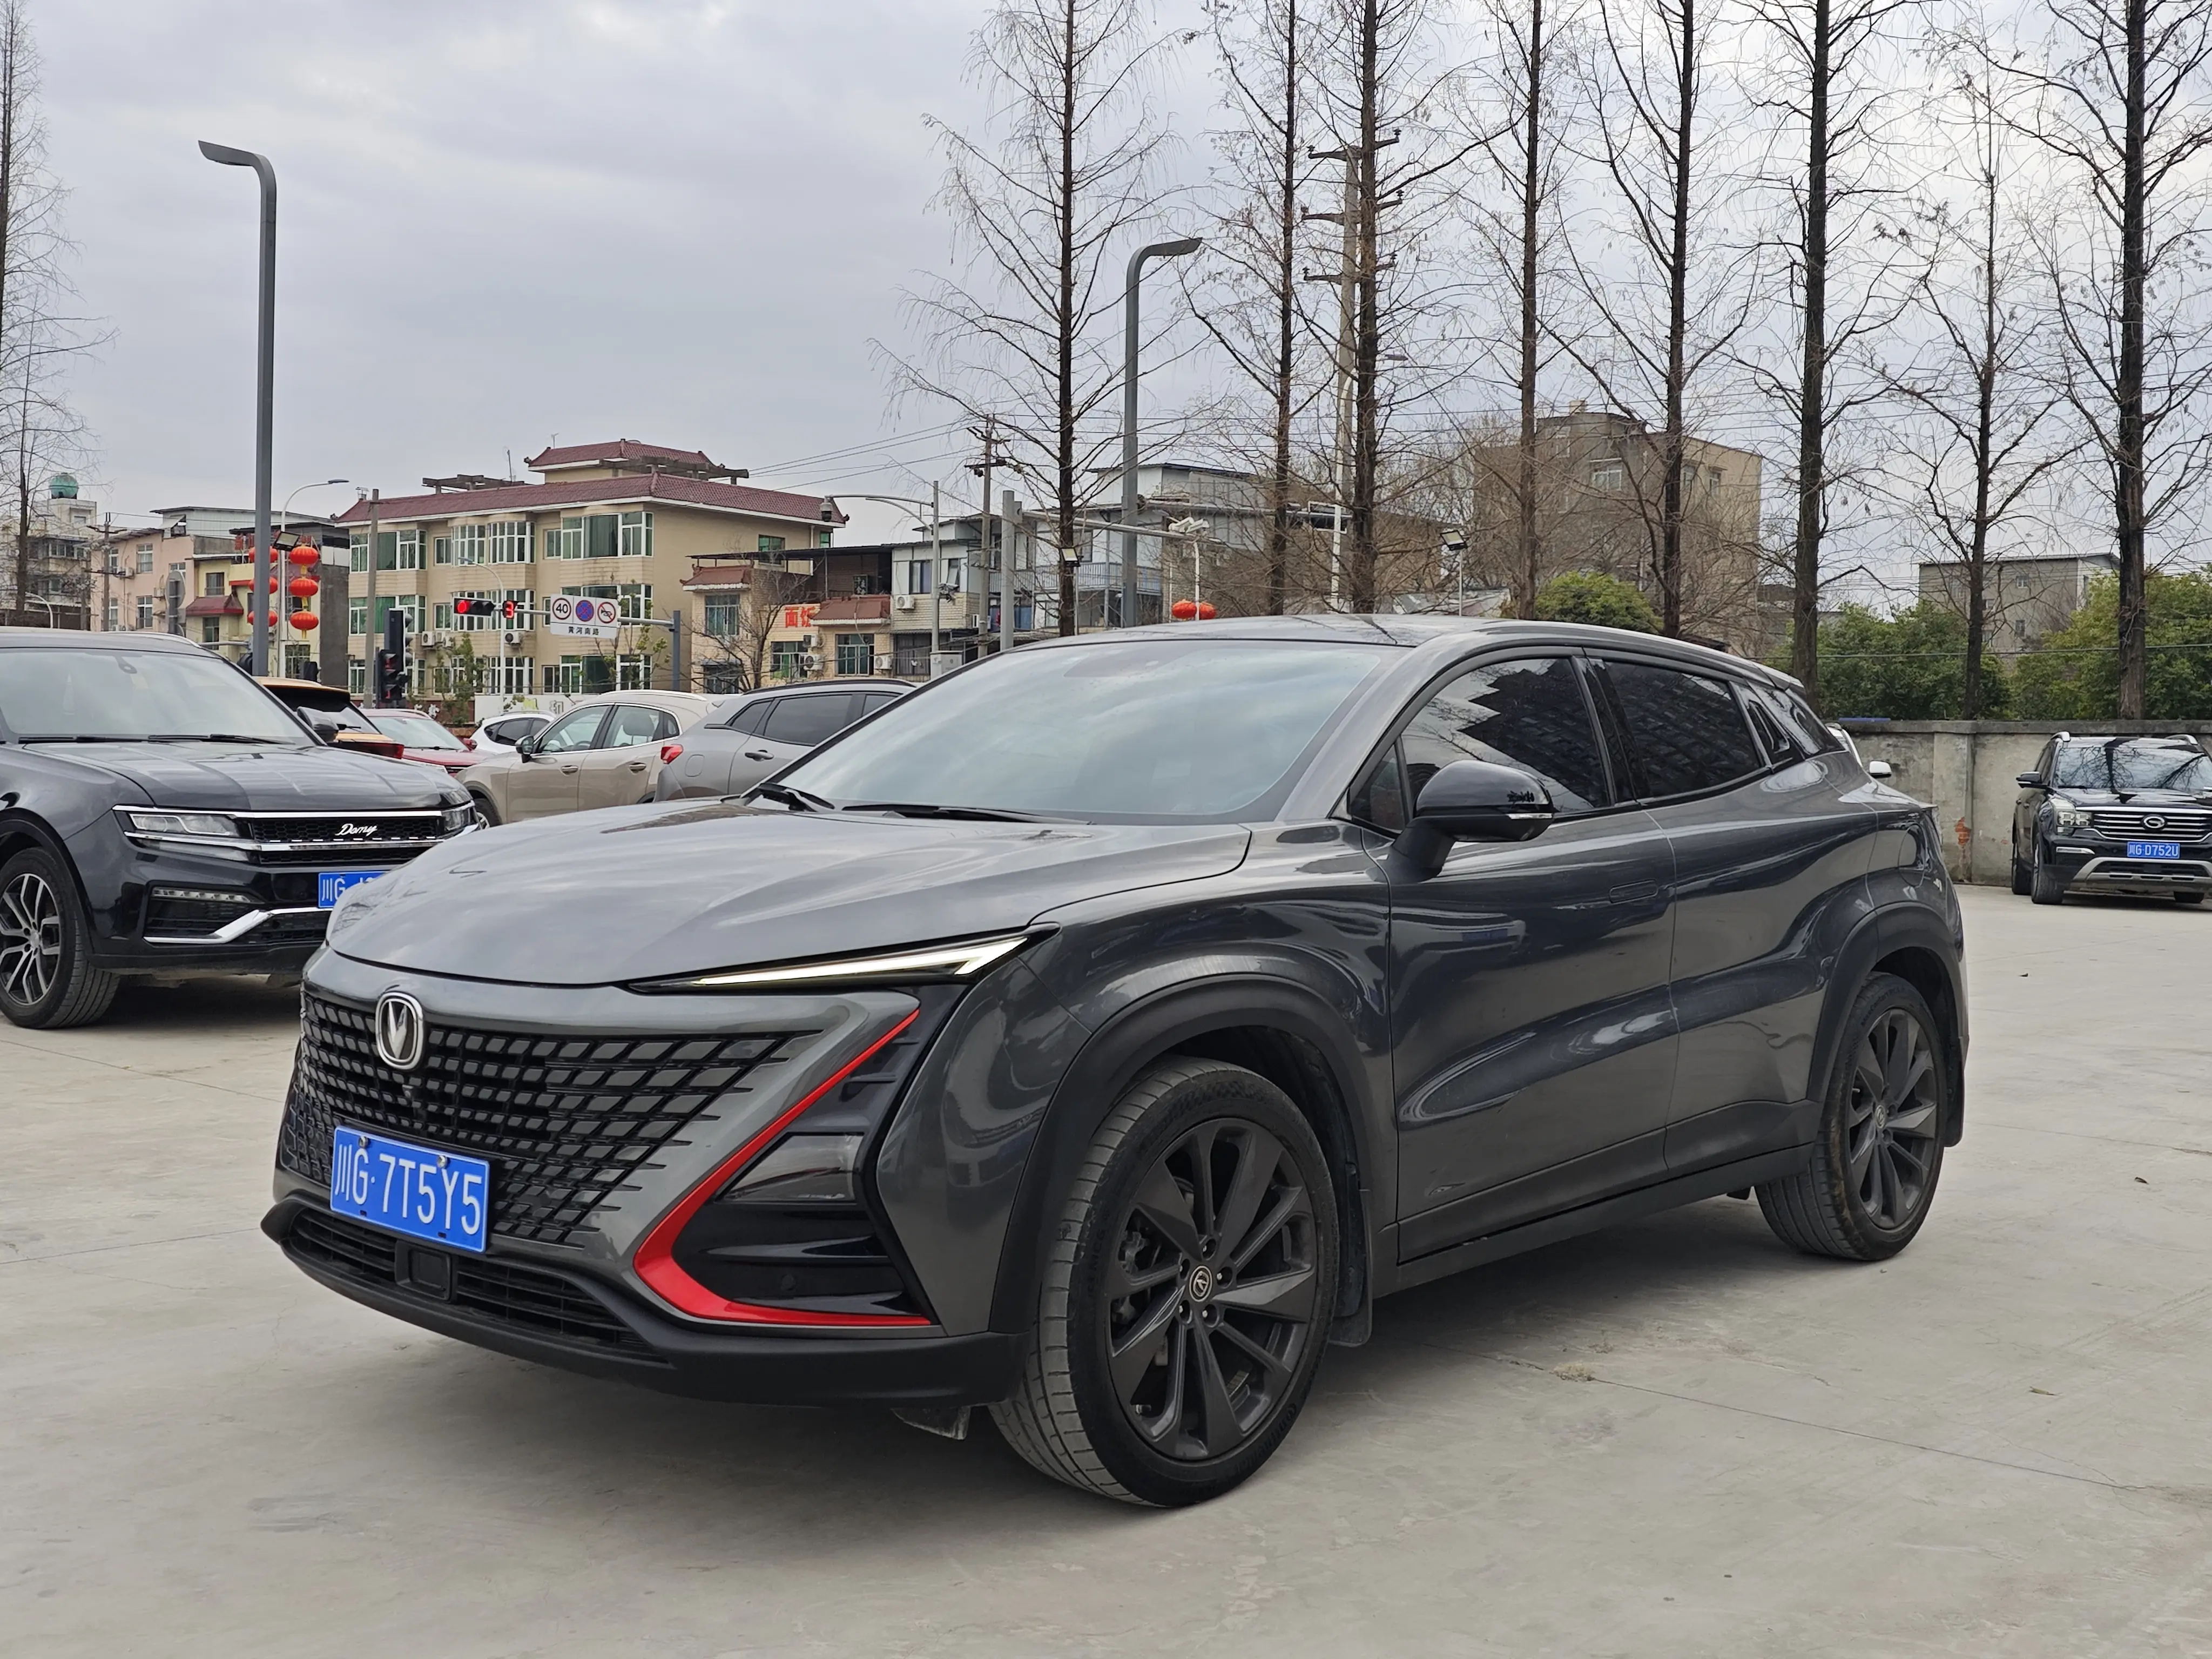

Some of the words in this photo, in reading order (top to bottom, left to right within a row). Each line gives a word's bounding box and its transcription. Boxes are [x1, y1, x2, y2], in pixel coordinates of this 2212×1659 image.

[556, 603, 568, 613] 40
[569, 626, 599, 635] 黄河南路
